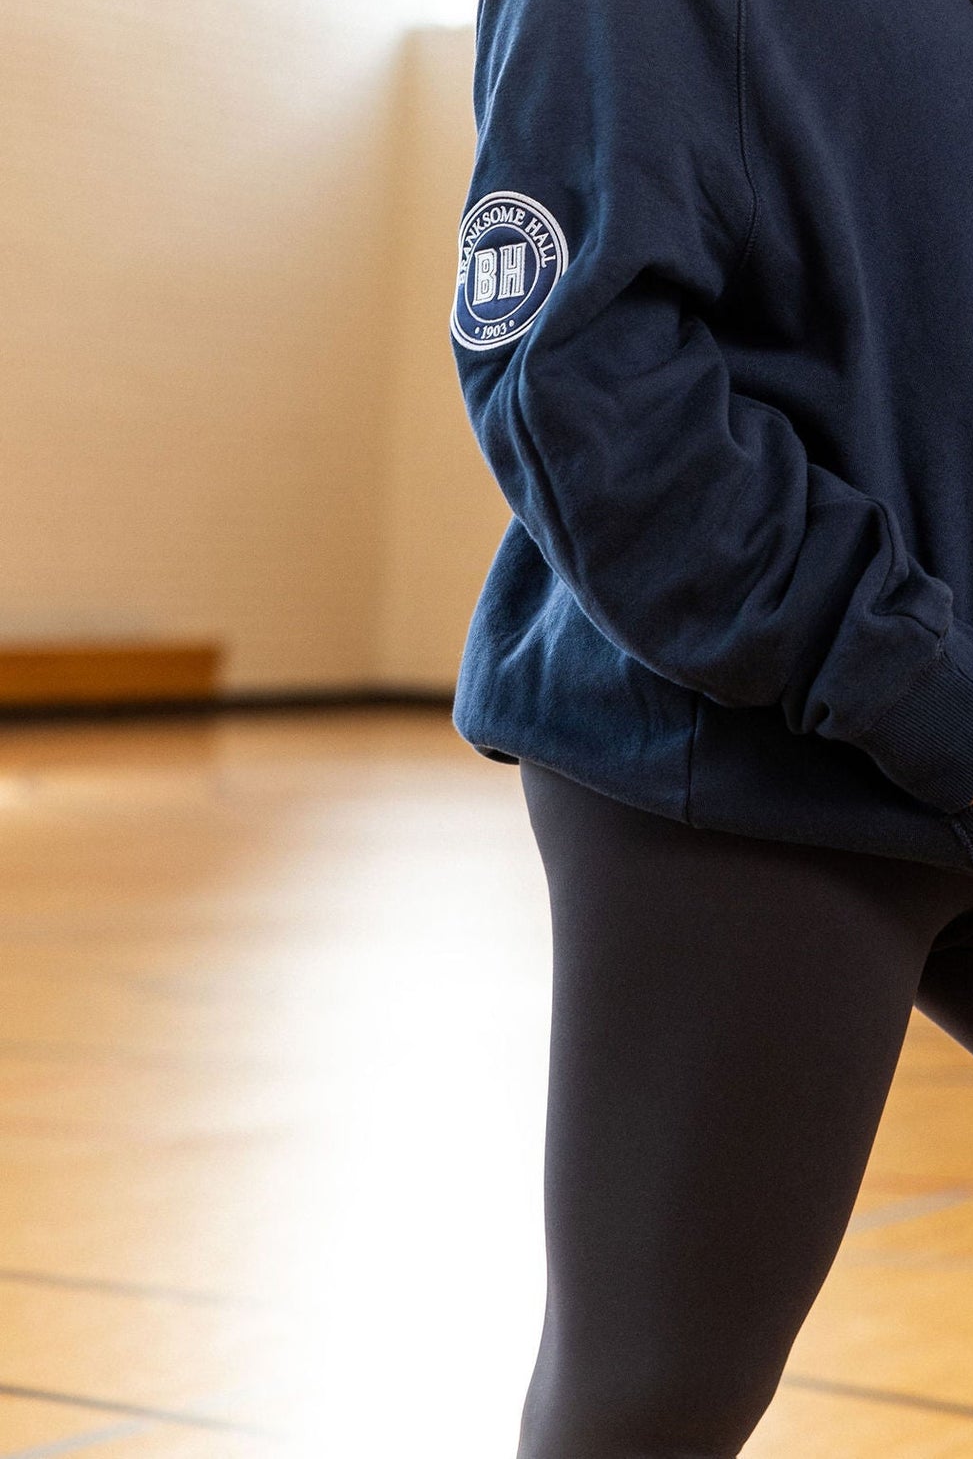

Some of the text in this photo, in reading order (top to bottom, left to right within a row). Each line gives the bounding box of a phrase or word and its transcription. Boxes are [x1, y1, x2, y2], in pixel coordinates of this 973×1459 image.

[525, 218, 556, 268] HALL
[472, 242, 527, 306] BH
[480, 322, 507, 339] 1903
